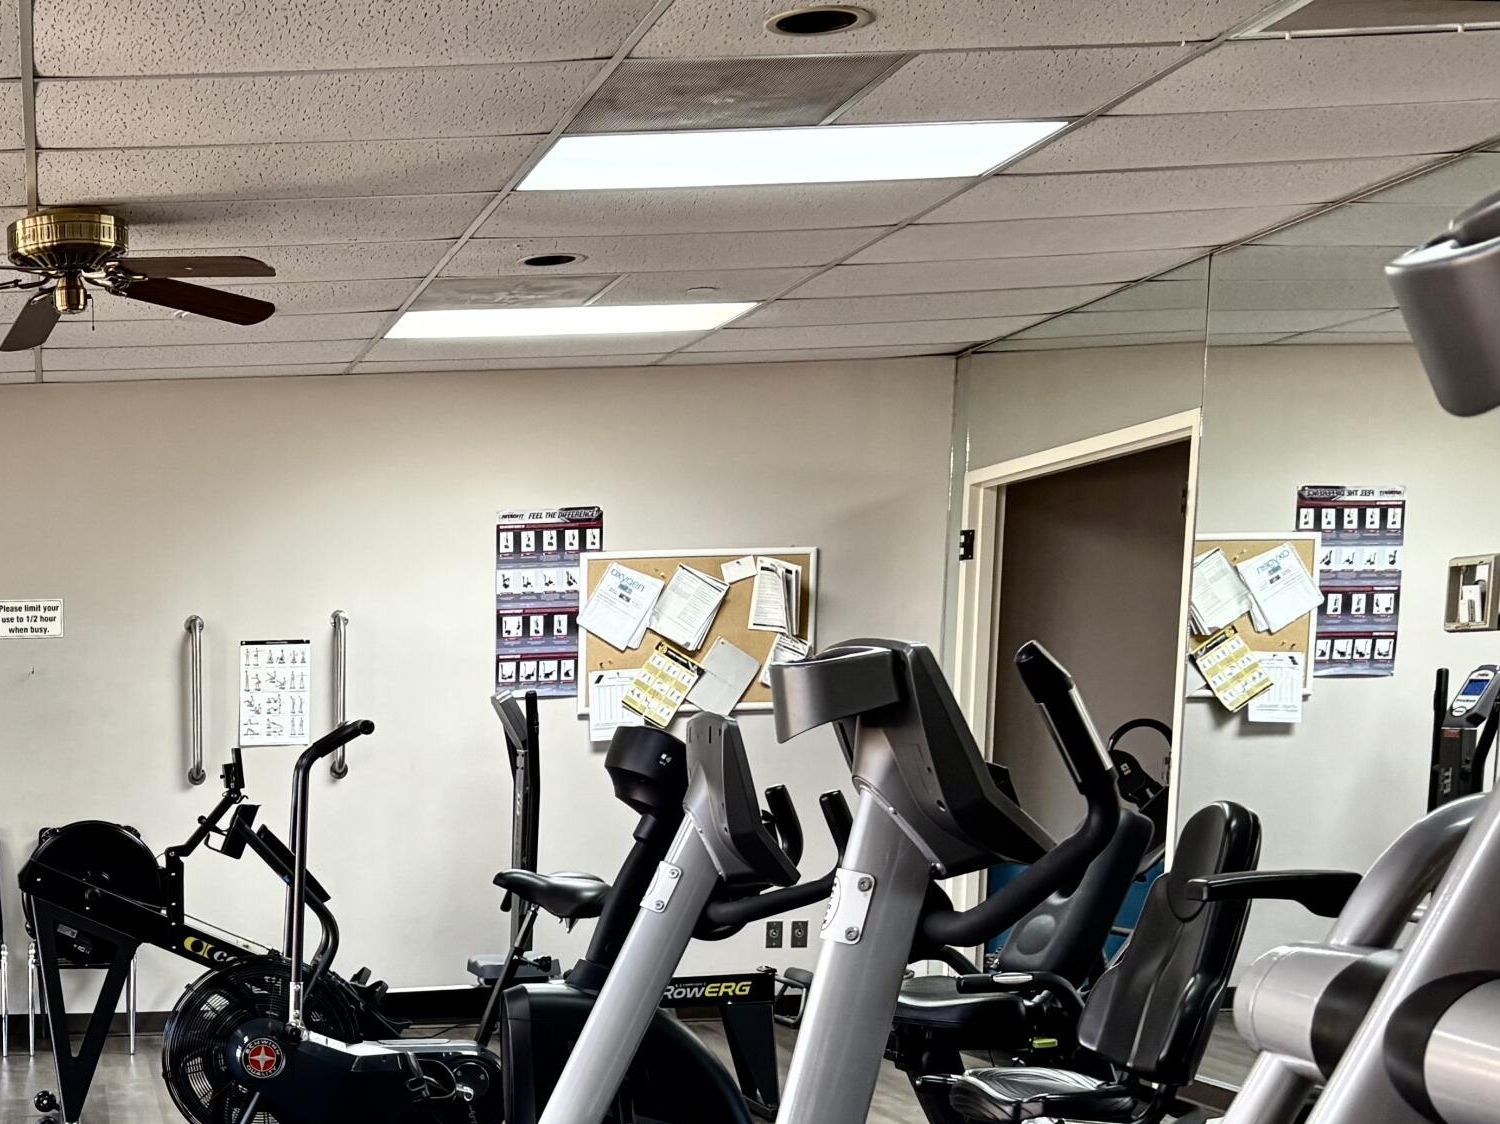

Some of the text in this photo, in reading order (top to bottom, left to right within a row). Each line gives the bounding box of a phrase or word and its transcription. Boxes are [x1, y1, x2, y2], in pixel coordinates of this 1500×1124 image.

[528, 512, 543, 520] FEEL
[24, 604, 41, 612] limit
[43, 605, 59, 613] your
[16, 615, 24, 623] to
[9, 626, 49, 634] when busy.
